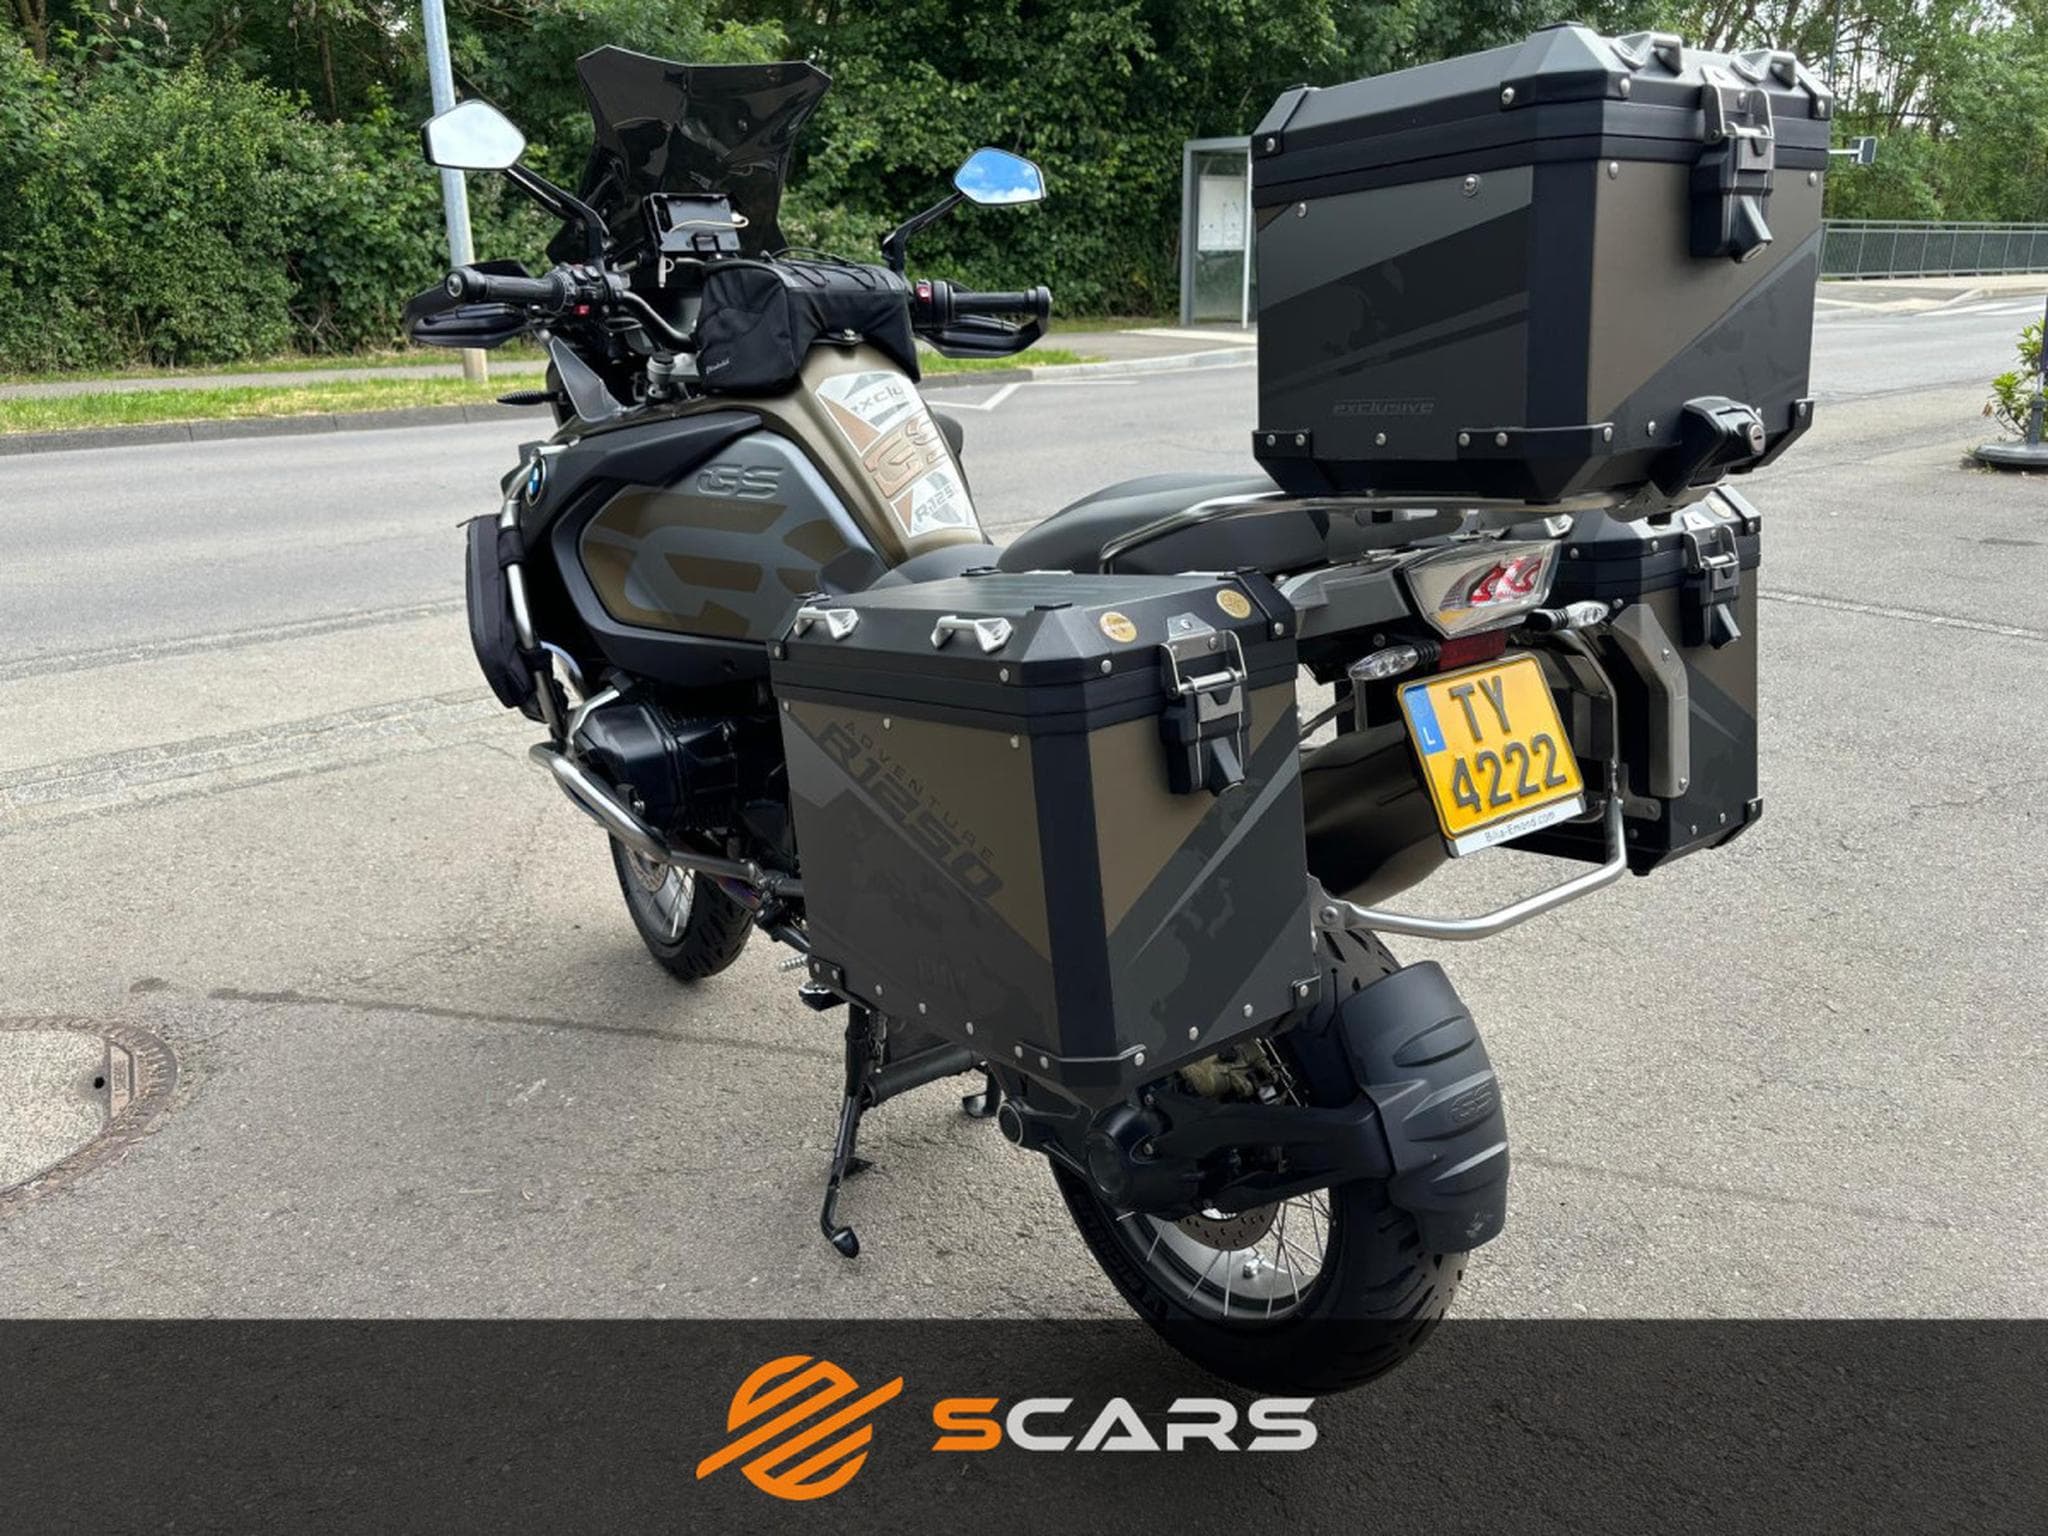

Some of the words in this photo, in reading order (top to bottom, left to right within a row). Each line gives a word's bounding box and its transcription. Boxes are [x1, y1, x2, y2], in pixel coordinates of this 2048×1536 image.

[697, 463, 784, 499] GS
[1422, 727, 1436, 746] L
[1449, 675, 1511, 742] TY
[844, 722, 995, 864] ADVENTURE
[1451, 733, 1567, 813] 4222
[817, 721, 1004, 899] R1250
